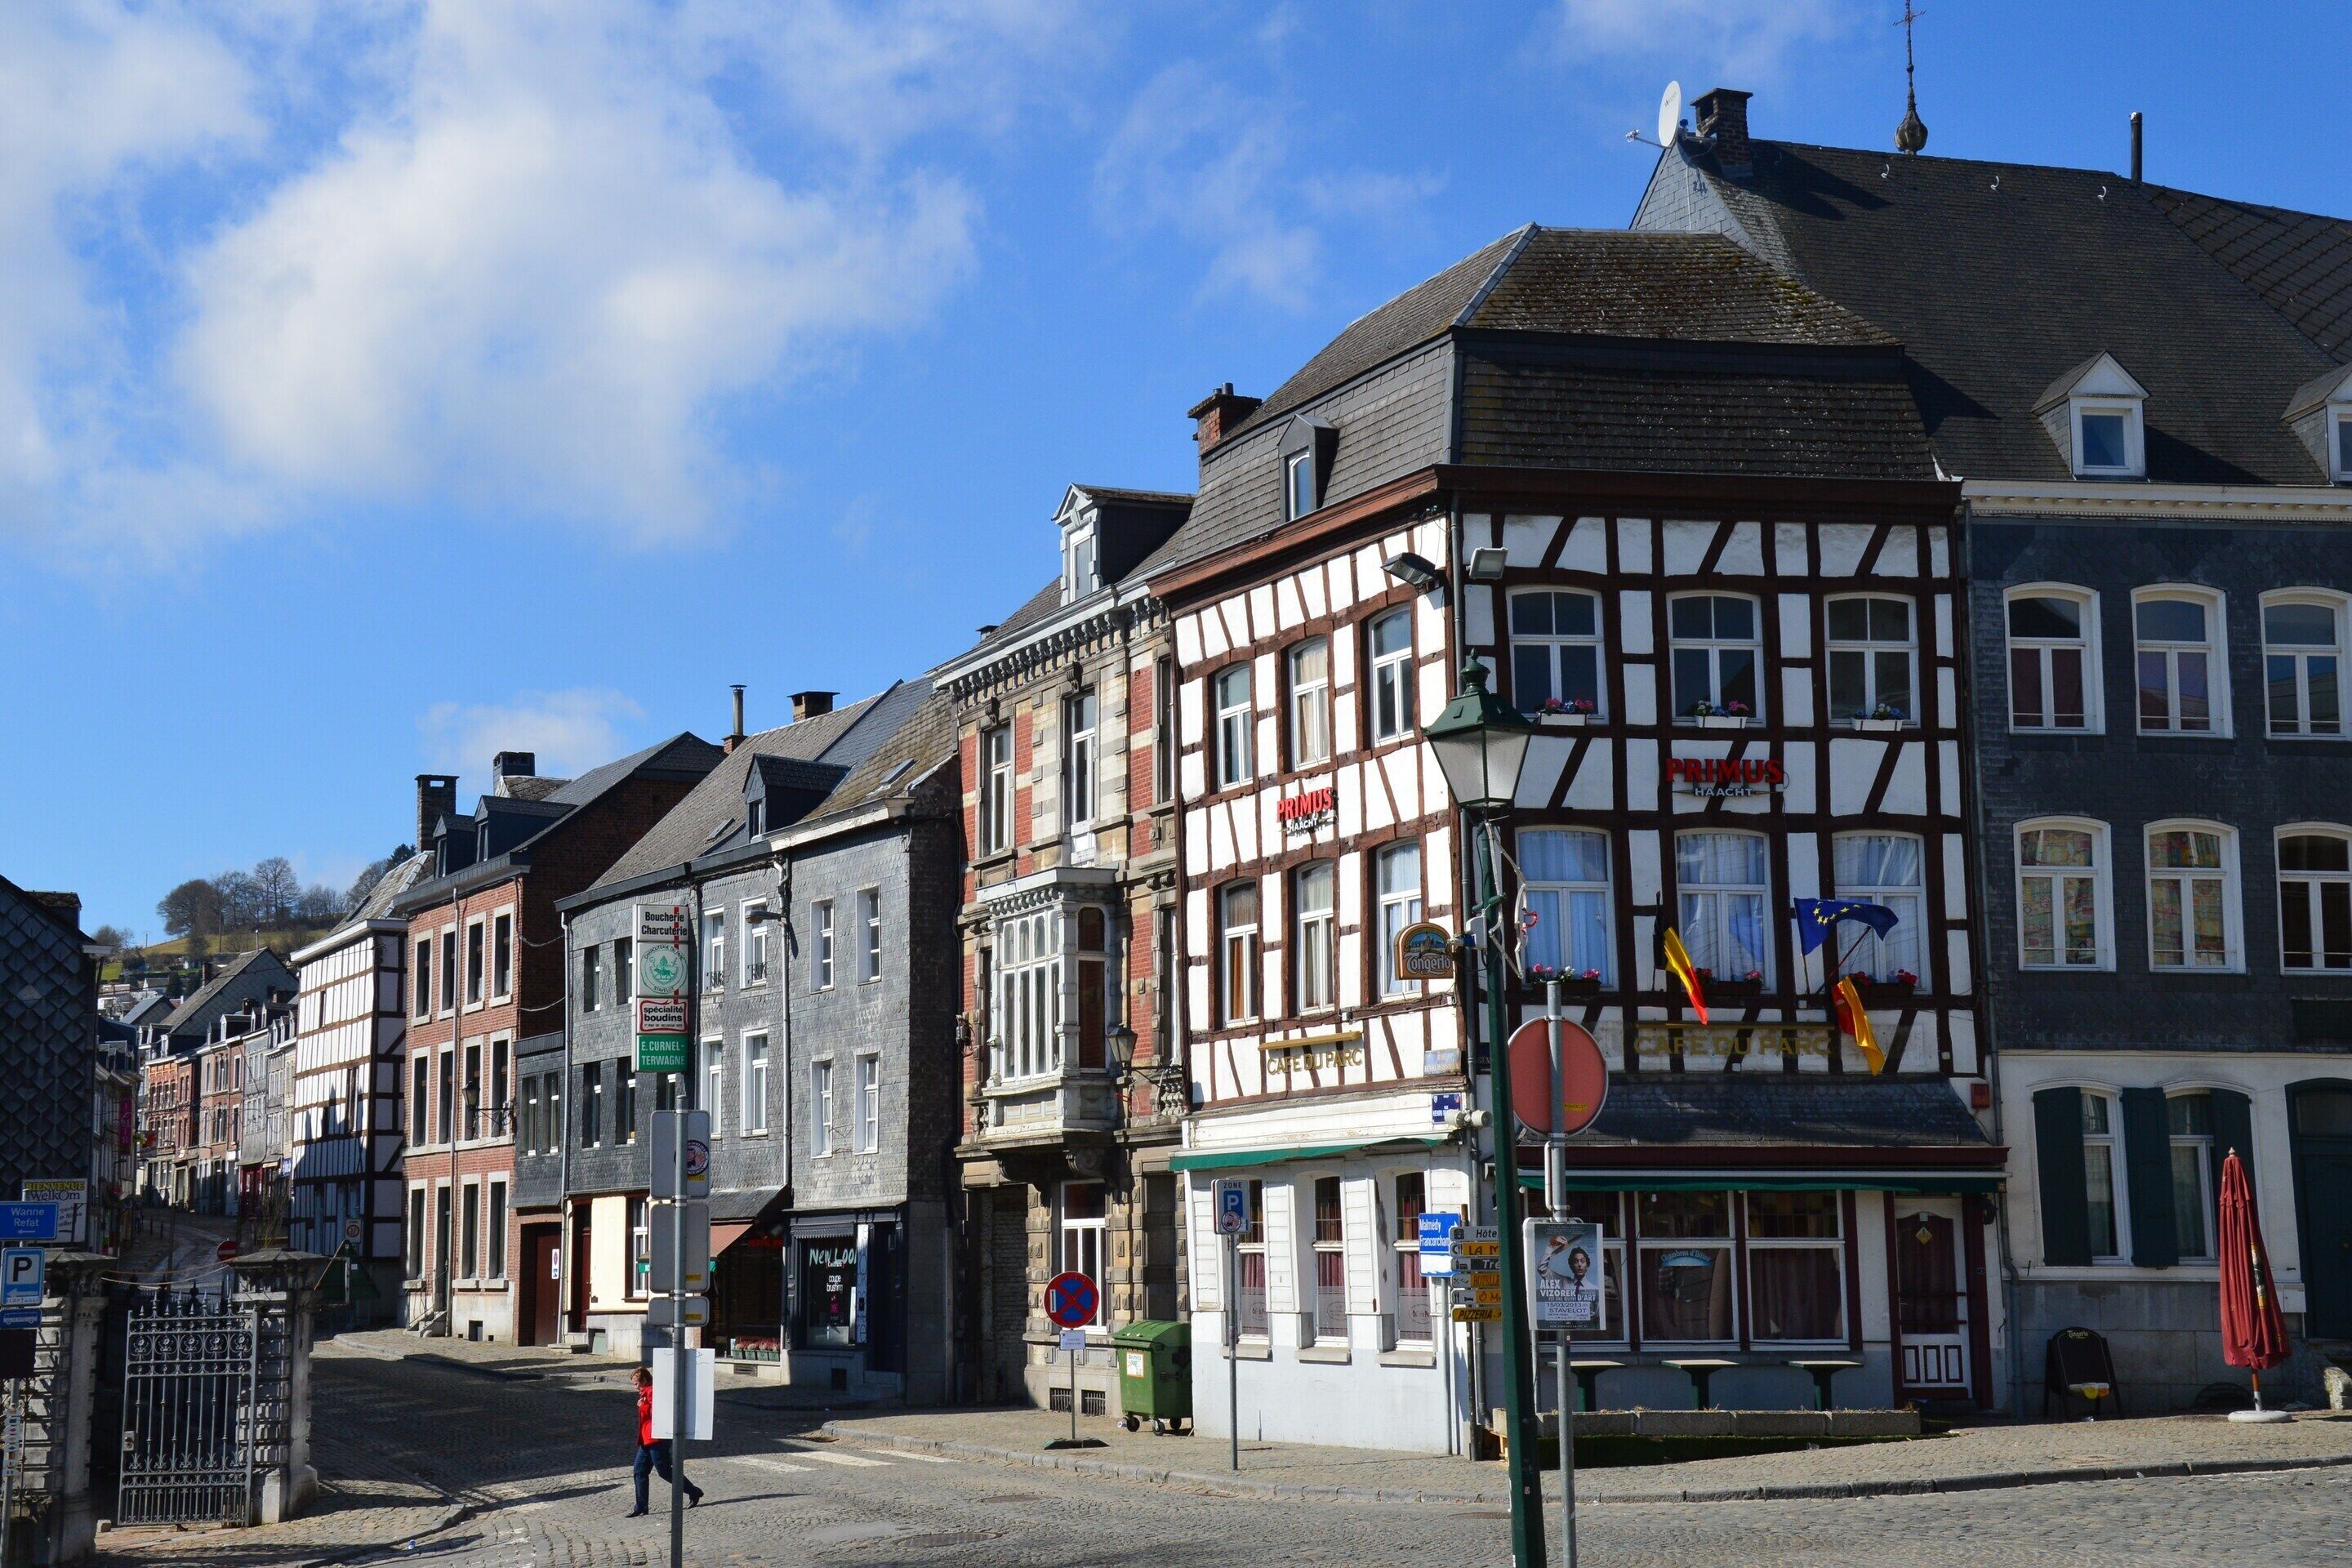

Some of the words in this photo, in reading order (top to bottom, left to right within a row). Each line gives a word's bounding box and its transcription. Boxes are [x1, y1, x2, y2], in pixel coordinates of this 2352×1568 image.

[1666, 758, 1784, 784] PRIMUS
[1695, 787, 1753, 796] HAACHT
[1276, 787, 1334, 823] PRIMUS
[1290, 818, 1318, 831] HAACHT
[645, 911, 684, 922] Boucherie
[642, 924, 688, 936] Charcuterie
[644, 945, 669, 960] CHARCUTERIE
[1404, 951, 1452, 975] Tongerlo
[644, 1013, 683, 1022] boudins
[1633, 1036, 1708, 1055] CAFE
[1714, 1036, 1752, 1055] DU
[1758, 1036, 1831, 1055] PARC
[642, 1055, 685, 1065] TERWAGNE
[1267, 1055, 1302, 1075] CAFE
[1303, 1053, 1323, 1071] DU
[1325, 1048, 1363, 1068] PARC
[26, 1182, 85, 1191] BIENVENUE
[1227, 1195, 1239, 1210] P
[11, 1207, 45, 1216] Wanne
[14, 1218, 39, 1227] Refat
[1419, 1218, 1441, 1232] Malmédy
[1469, 1245, 1482, 1255] LA
[1660, 1250, 1689, 1262] Chambres
[809, 1248, 831, 1267] New
[13, 1257, 33, 1282] P
[828, 1275, 842, 1284] coupe
[1540, 1279, 1561, 1290] ALEX
[826, 1283, 844, 1293] brushing
[1490, 1292, 1501, 1302] M
[1577, 1294, 1596, 1302] D'ART
[1459, 1309, 1493, 1321] PIZZERIA
